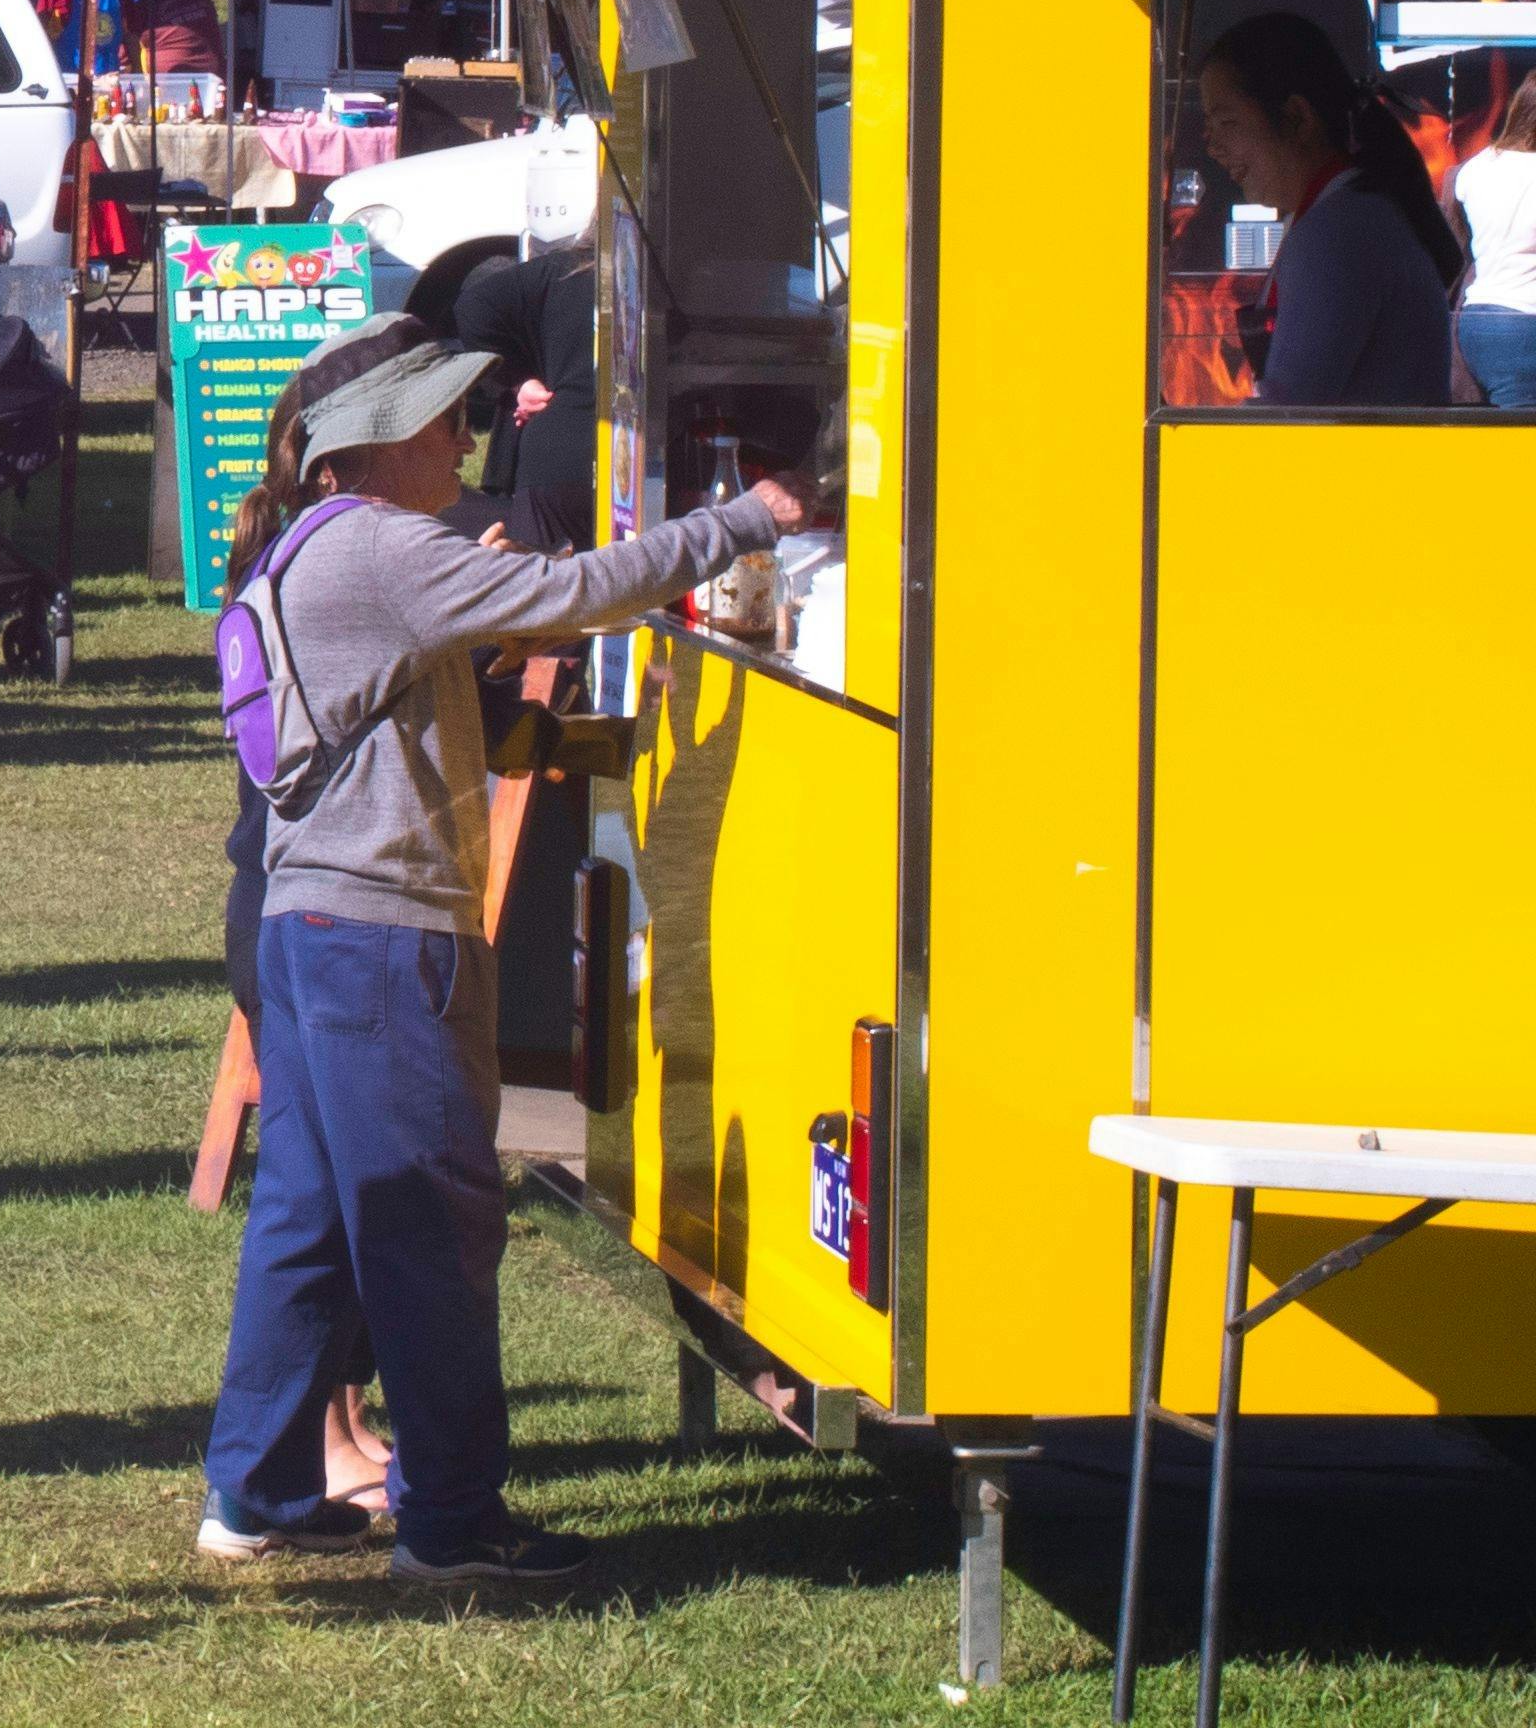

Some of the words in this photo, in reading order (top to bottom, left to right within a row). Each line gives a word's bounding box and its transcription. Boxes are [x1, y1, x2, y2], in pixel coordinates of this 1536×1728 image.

[175, 288, 367, 322] HAP'S
[195, 324, 286, 341] HEALTH
[292, 323, 341, 340] BAR
[213, 358, 256, 372] MANGO
[258, 358, 303, 372] SMOOT
[214, 384, 261, 396] BANANA
[215, 408, 263, 422] ORANGE
[217, 433, 259, 446] MANGO
[218, 459, 253, 473] FRUIT
